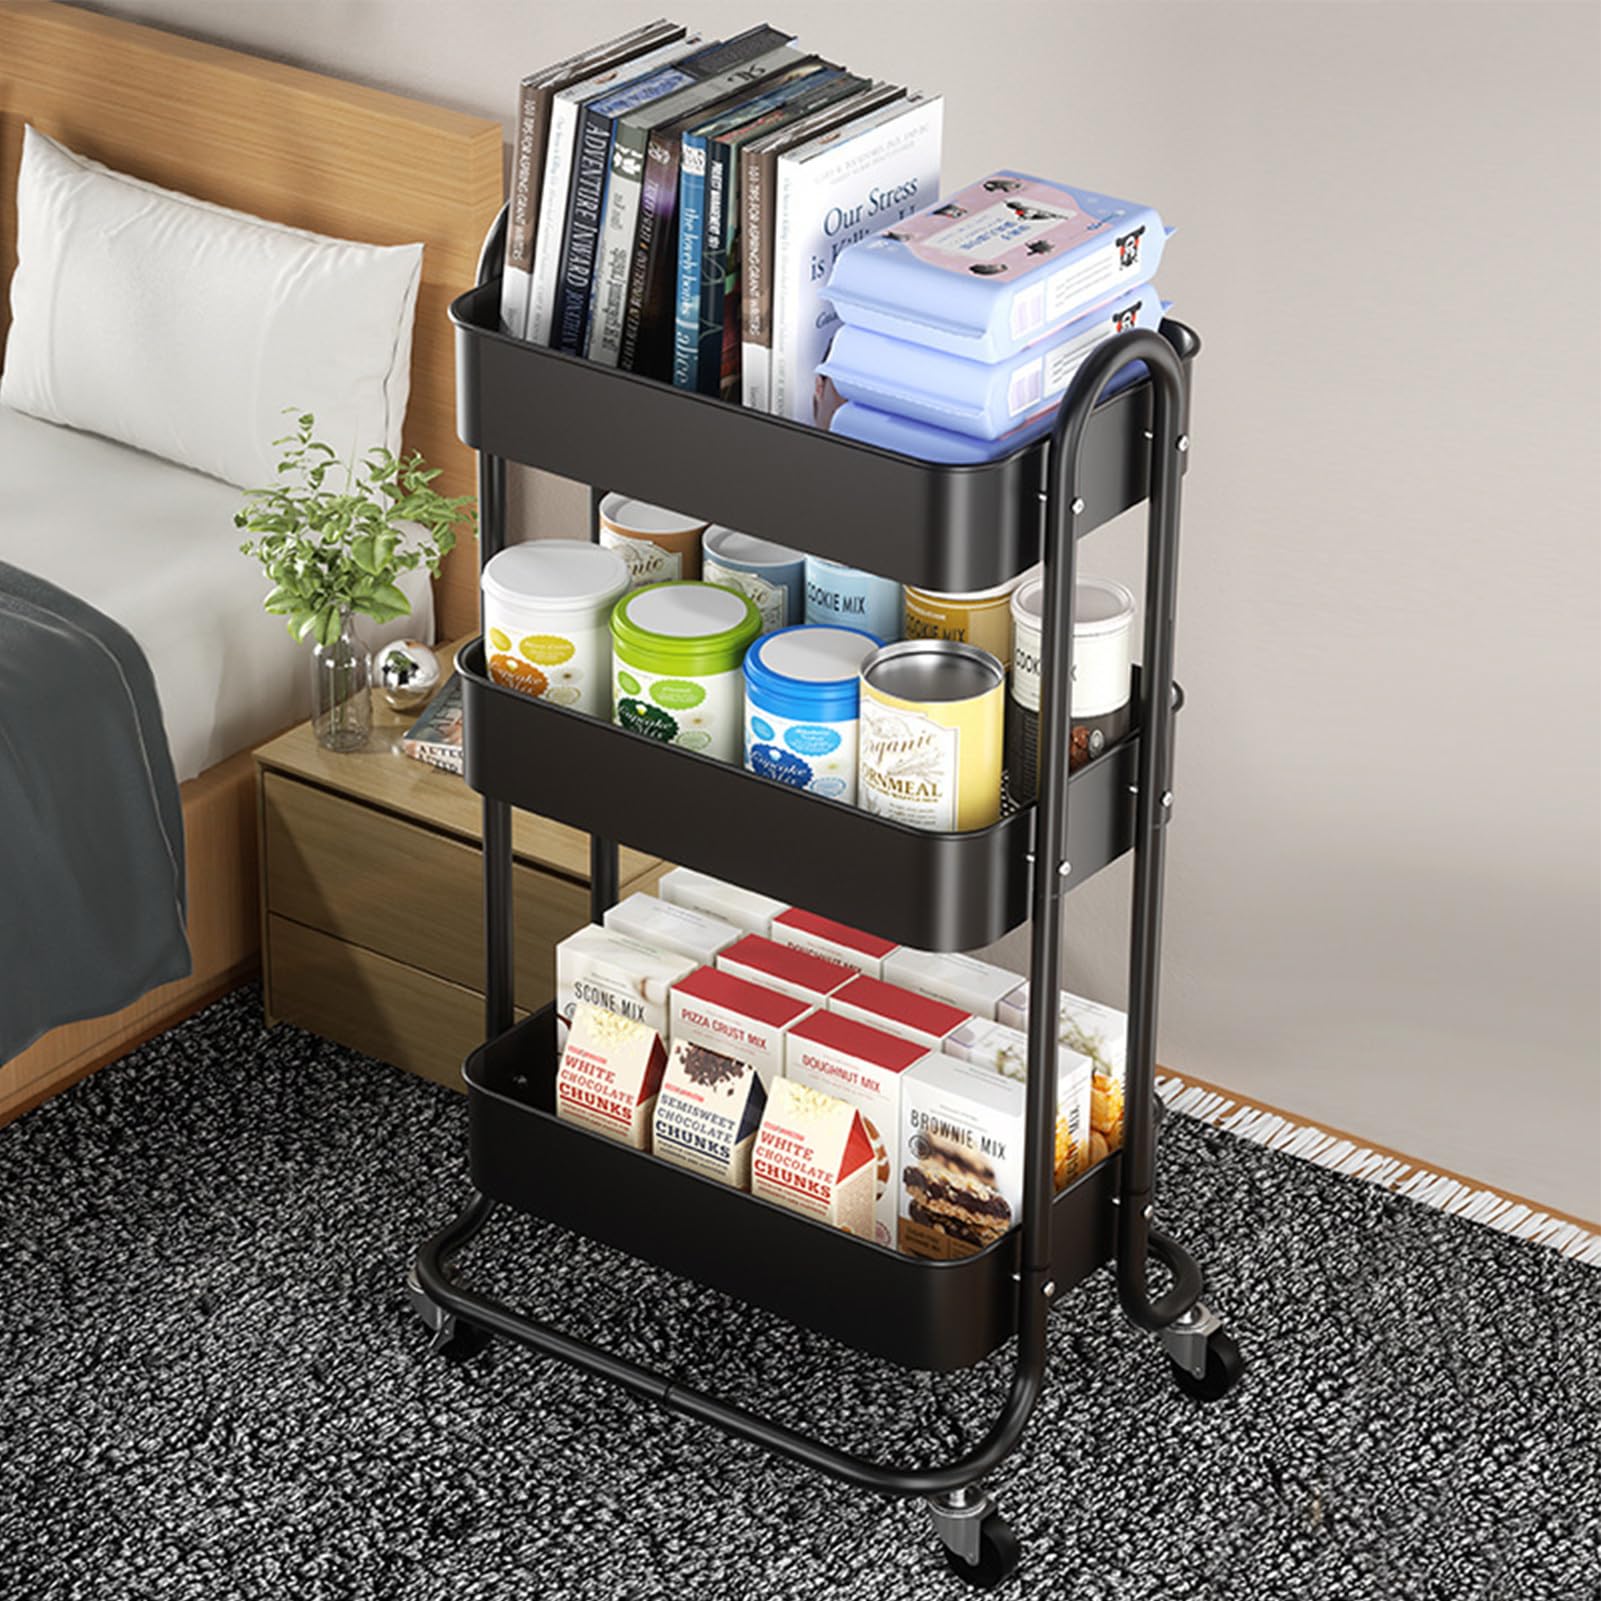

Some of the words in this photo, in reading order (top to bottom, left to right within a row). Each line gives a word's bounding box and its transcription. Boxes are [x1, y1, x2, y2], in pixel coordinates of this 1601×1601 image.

[575, 121, 611, 221] ADVENTURE
[824, 206, 862, 237] Our
[867, 178, 919, 217] Stress
[566, 221, 599, 288] INWARD
[810, 255, 826, 281] is
[675, 331, 699, 383] alice
[842, 595, 866, 615] MIX
[1016, 647, 1041, 676] COOK
[865, 766, 943, 798] RNMEAL
[574, 981, 616, 1013] SCONE
[621, 999, 645, 1023] MIX
[681, 1008, 710, 1028] PIZZA
[712, 1019, 745, 1041] CRUST
[747, 1033, 767, 1050] MIX
[560, 1068, 634, 1106] CHOCOLATE
[565, 1055, 616, 1085] WHITE
[802, 1053, 859, 1085] DOUGHNUT
[860, 1076, 881, 1094] MIX
[559, 1081, 632, 1120] CHUNKS
[660, 1093, 736, 1131] SEMISWEET
[656, 1107, 734, 1145] CHOCOLATE
[656, 1119, 731, 1159] CHUNKS
[910, 1109, 974, 1150] BROWNIE
[980, 1135, 1007, 1161] MIX
[755, 1145, 834, 1184] CHOCOLATE
[760, 1130, 814, 1162] WHITE
[754, 1158, 831, 1199] CHUNKS
